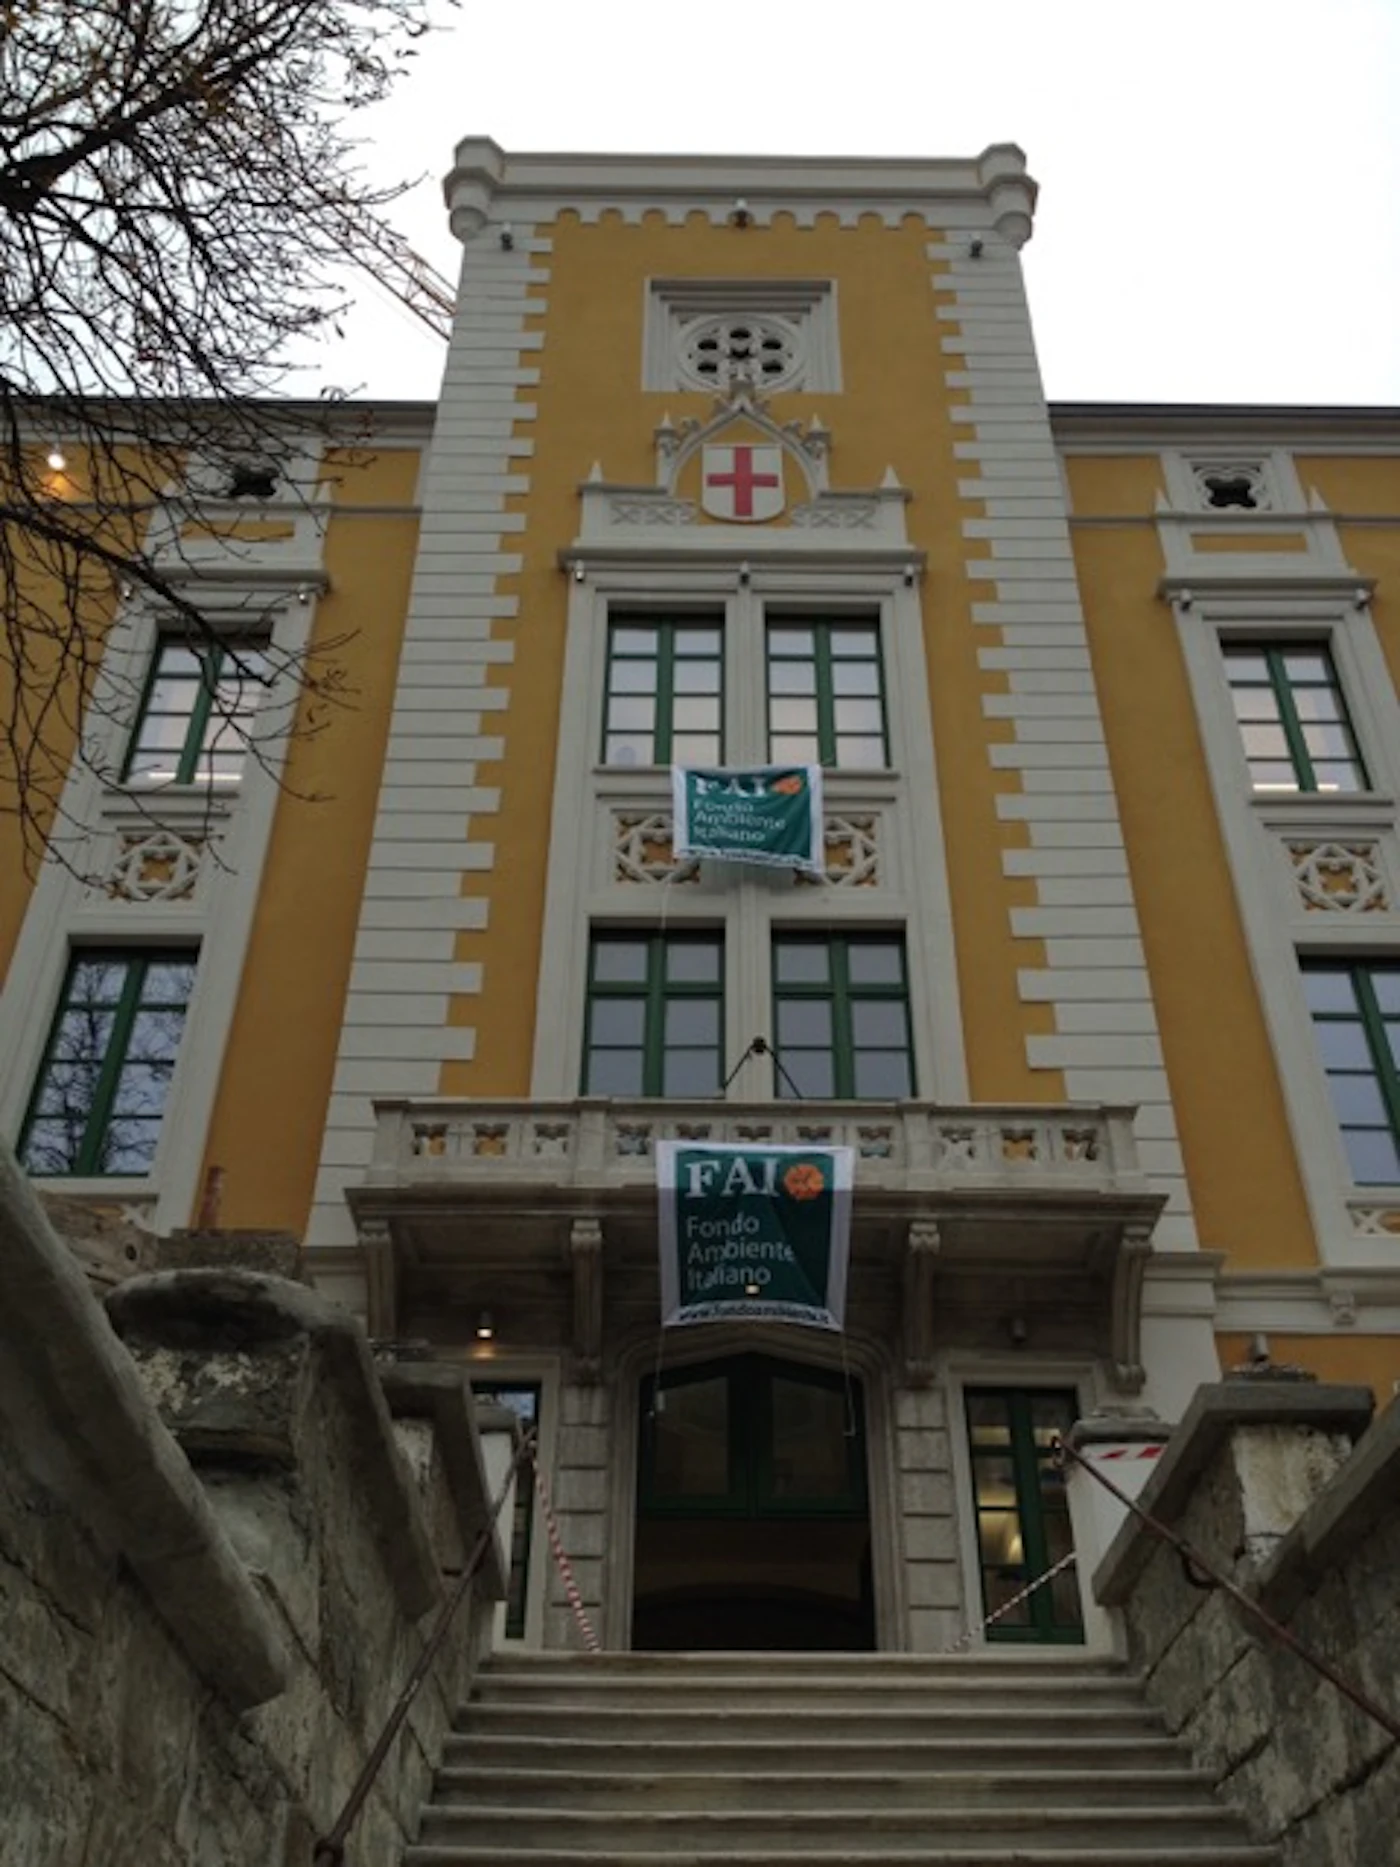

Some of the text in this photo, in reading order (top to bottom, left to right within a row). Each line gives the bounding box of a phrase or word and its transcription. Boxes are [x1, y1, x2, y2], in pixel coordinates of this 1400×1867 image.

[695, 777, 767, 798] FAI
[684, 1158, 780, 1198] FAI
[687, 1212, 760, 1238] Fondo
[688, 1238, 795, 1263] Ambiente
[688, 1265, 772, 1290] Italiano
